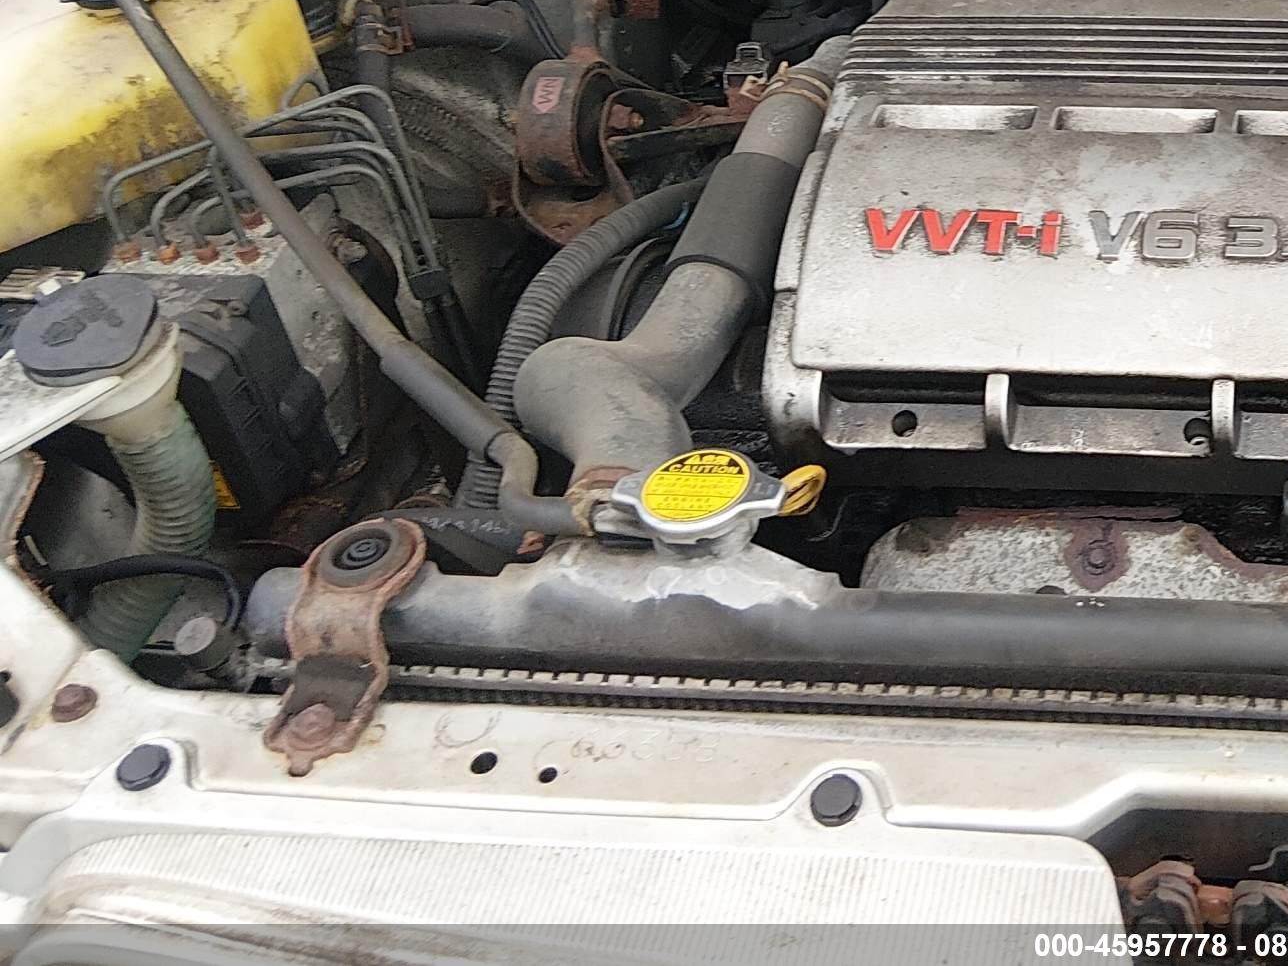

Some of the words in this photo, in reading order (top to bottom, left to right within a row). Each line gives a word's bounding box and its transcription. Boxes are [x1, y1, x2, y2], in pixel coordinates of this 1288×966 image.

[865, 208, 1063, 257] VVT-i
[1088, 210, 1200, 262] V6
[668, 464, 741, 475] CAUTION
